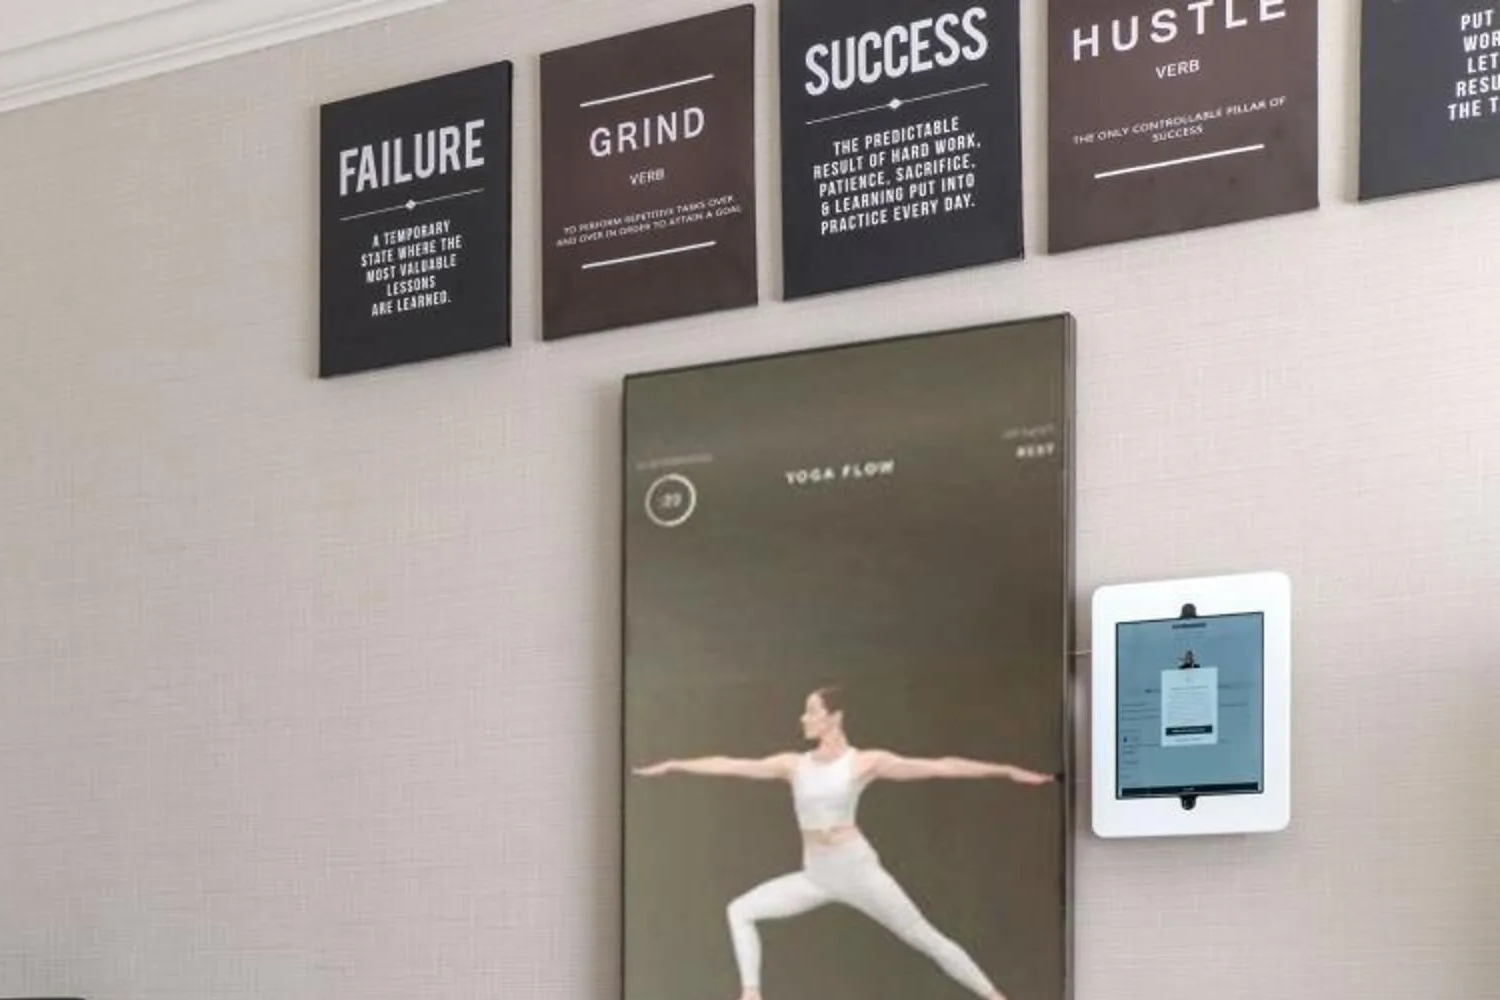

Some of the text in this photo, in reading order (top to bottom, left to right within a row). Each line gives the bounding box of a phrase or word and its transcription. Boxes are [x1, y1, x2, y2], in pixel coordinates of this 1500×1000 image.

[1073, 0, 1287, 61] HUSTLE
[1461, 9, 1494, 31] PUT
[804, 6, 988, 96] SUCCESS
[1467, 52, 1499, 74] LET
[1155, 59, 1201, 79] VERB
[1073, 96, 1287, 146] THE ONLY CONTROLLABLE PILLAR OF
[1448, 99, 1482, 121] THE
[589, 106, 706, 158] GRIND
[833, 116, 960, 156] THE PREDICTABLE
[1151, 124, 1204, 142] SUCCESS
[339, 118, 485, 197] FAILURE
[813, 155, 864, 180] RESULT
[869, 151, 886, 168] OF
[891, 143, 929, 164] HARD
[629, 167, 666, 186] VERB
[821, 172, 975, 217] & LEARNING PUT INTO
[821, 209, 888, 236] PRACTICE
[893, 199, 939, 222] EVERY
[361, 233, 462, 268] STATE WHERE THE
[372, 233, 380, 249] A
[366, 264, 396, 283] MOST
[386, 275, 436, 297] LESSONS
[371, 300, 393, 317] ARE
[785, 459, 894, 485] YOGA FLOW
